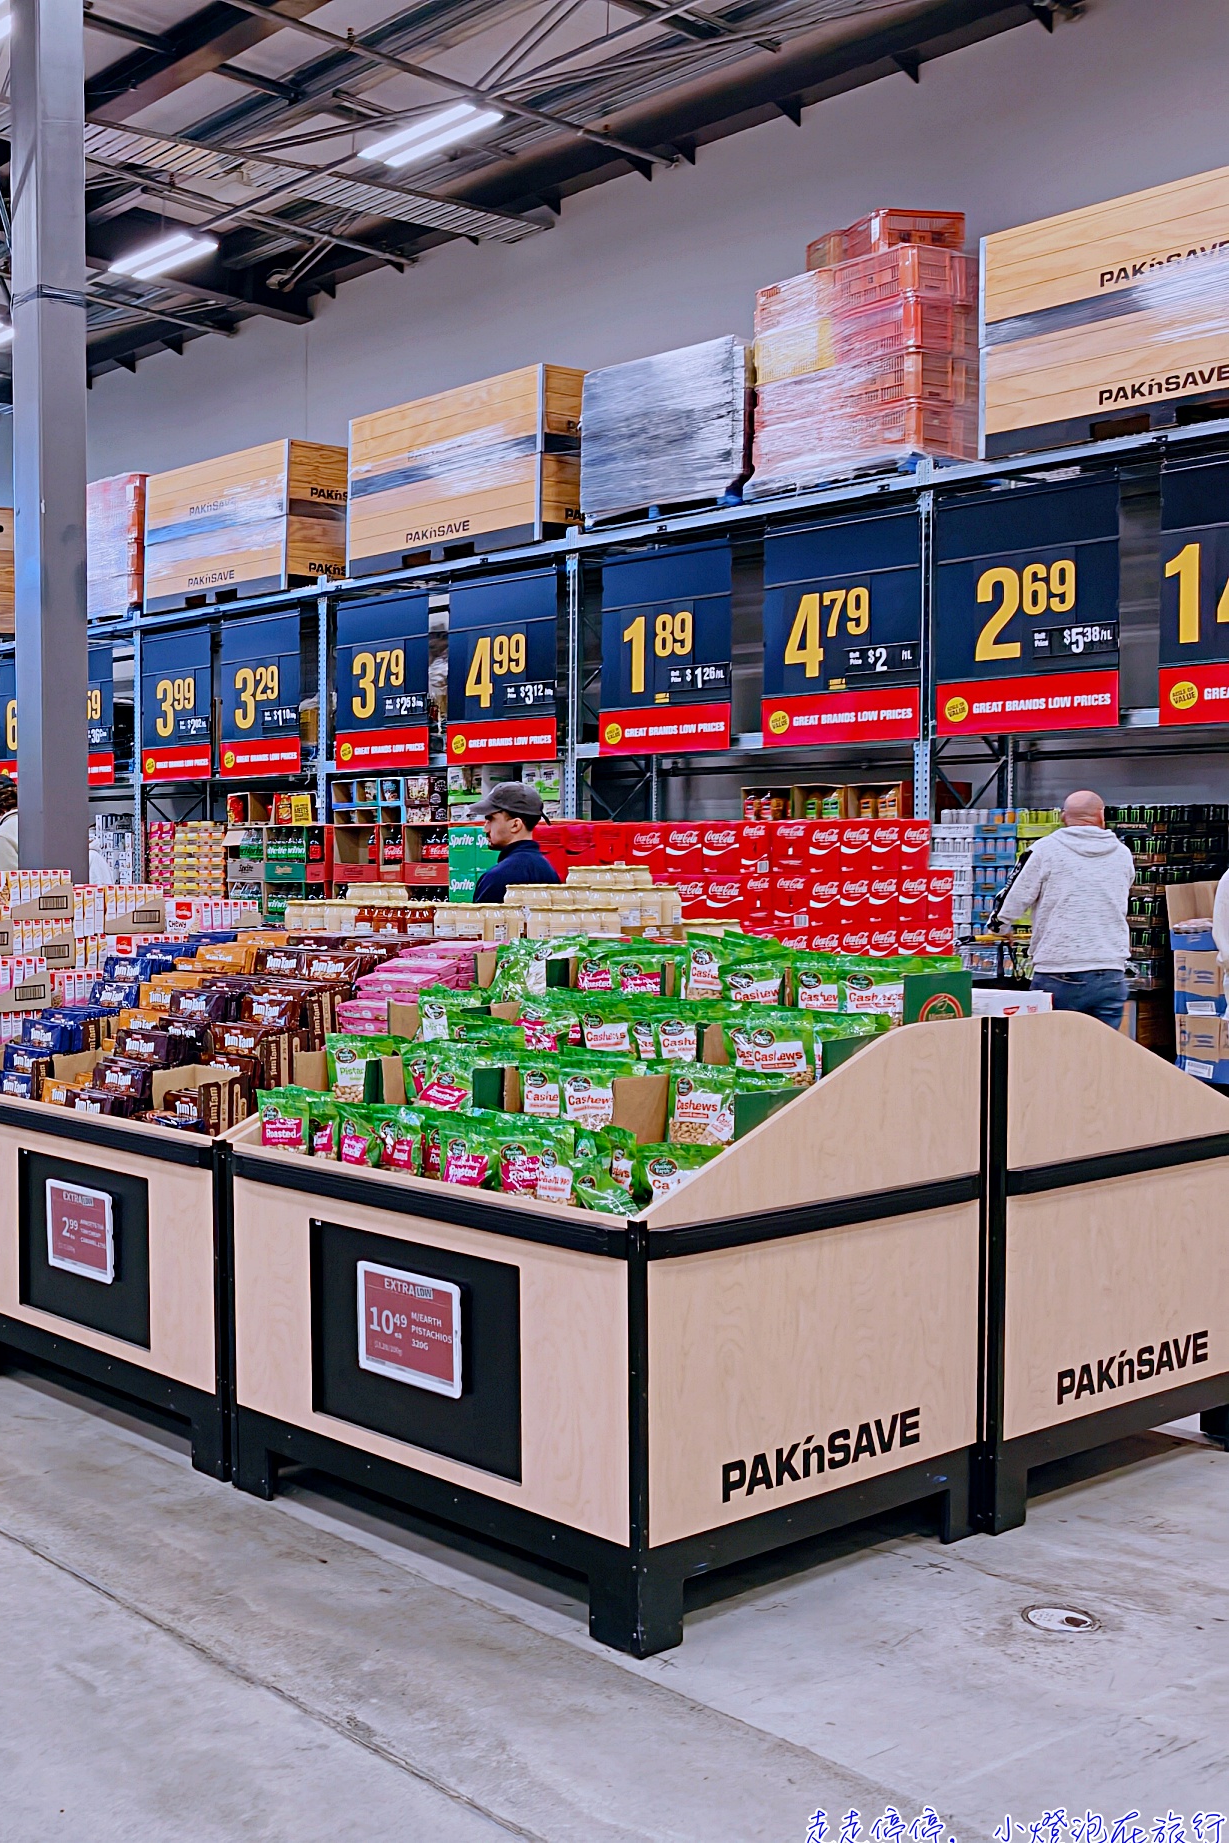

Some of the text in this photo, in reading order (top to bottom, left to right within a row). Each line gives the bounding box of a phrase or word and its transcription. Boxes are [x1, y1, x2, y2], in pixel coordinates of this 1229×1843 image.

[1165, 543, 1229, 643] 1
[973, 693, 1111, 714] GREAT BRANDS LOW PRICES
[793, 708, 913, 726] GREAT BRANDS LOW PRICES
[625, 722, 725, 738] GREAT BRANDS LOW PRICES
[449, 834, 474, 848] Sprite
[449, 879, 475, 892] Sprite
[677, 1099, 718, 1112] Cashews
[385, 1278, 415, 1296] EXTRA
[411, 1325, 452, 1344] PISTACHIOS
